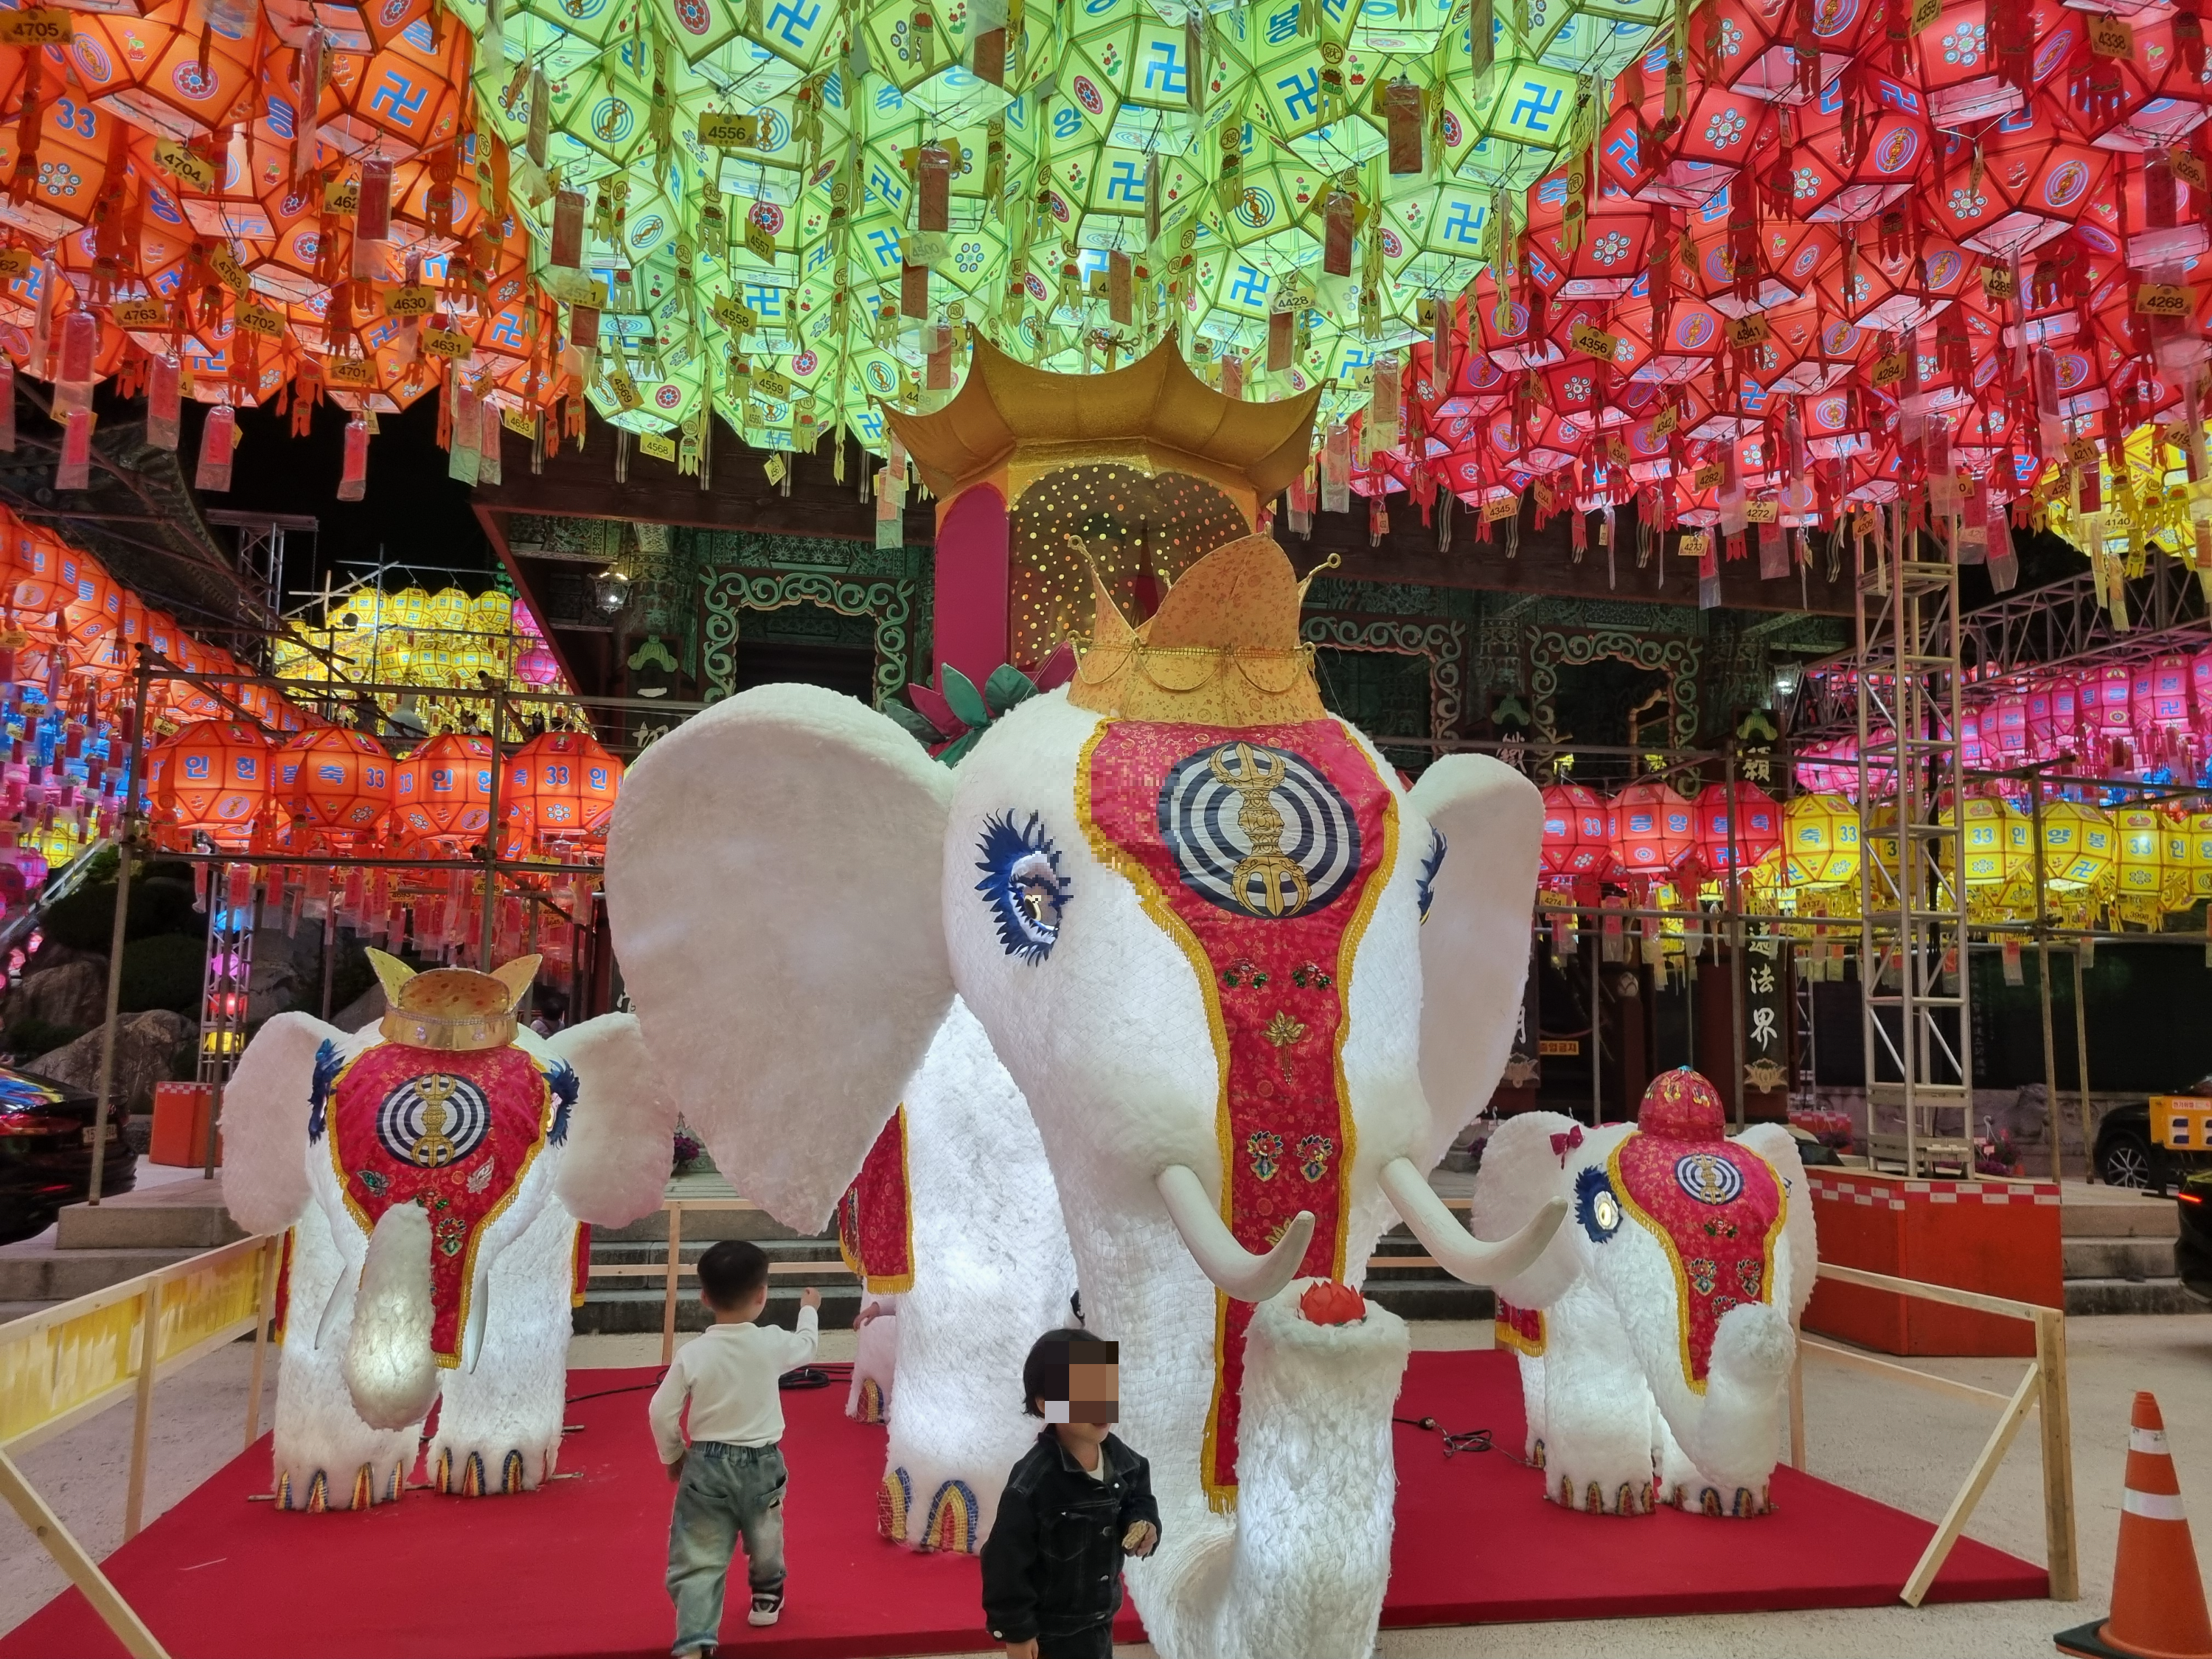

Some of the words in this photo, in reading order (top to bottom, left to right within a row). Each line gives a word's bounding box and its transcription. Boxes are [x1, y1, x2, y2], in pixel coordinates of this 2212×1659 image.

[1916, 1, 1937, 24] 4359
[14, 23, 58, 37] 4705
[2098, 32, 2126, 49] 4338
[57, 99, 96, 138] 33
[709, 128, 745, 140] 4556
[164, 153, 201, 181] 4704
[2177, 161, 2200, 181] 4286
[1540, 178, 1567, 205] 축
[333, 195, 356, 209] 462
[751, 235, 769, 254] 4557
[0, 260, 18, 272] 62
[219, 262, 242, 288] 4703
[394, 298, 426, 309] 4630
[1279, 296, 1309, 308] 4428
[2146, 297, 2183, 310] 4268
[124, 310, 158, 320] 4763
[243, 313, 276, 331] 4702
[721, 309, 749, 327] 4558
[1737, 326, 1761, 341] 4341
[431, 338, 462, 353] 4631
[1579, 337, 1607, 354] 4356
[338, 367, 367, 378] 4701
[1877, 366, 1899, 380] 4284
[613, 377, 633, 403] 4569
[759, 380, 783, 394] 4559
[510, 417, 529, 431] 4633
[1657, 417, 1672, 433] 4342
[2171, 431, 2191, 444] 419
[647, 442, 669, 454] 4568
[1612, 447, 1627, 462] 4343
[2074, 446, 2093, 460] 4211
[1700, 472, 1719, 484] 4282
[2052, 482, 2070, 495] 420
[1489, 504, 1510, 516] 4345
[1747, 509, 1770, 518] 4272
[1857, 519, 1874, 533] 4209
[2105, 518, 2130, 526] 4140
[1684, 543, 1703, 551] 4273
[185, 757, 209, 779] 인
[237, 757, 257, 780] 헌
[282, 765, 299, 785] 봉
[318, 765, 345, 785] 축
[366, 768, 386, 789] 33
[399, 773, 413, 793] 33
[432, 770, 453, 790] 인
[514, 768, 528, 786] 축
[546, 765, 569, 785] 33
[589, 768, 608, 790] 인
[1545, 819, 1565, 836] 축
[1583, 818, 1601, 837] 33
[1669, 815, 1687, 832] 양
[1713, 817, 1728, 834] 봉
[1750, 814, 1769, 831] 축
[1800, 829, 1820, 844] 축
[1840, 825, 1858, 843] 33
[1972, 827, 1994, 844] 33
[2012, 827, 2026, 845] 인
[2047, 829, 2071, 844] 양
[2087, 832, 2106, 848] 봉
[1887, 841, 1897, 857] 3
[2129, 838, 2152, 855] 33
[2170, 840, 2185, 858] 인
[1545, 898, 1562, 906] 4274
